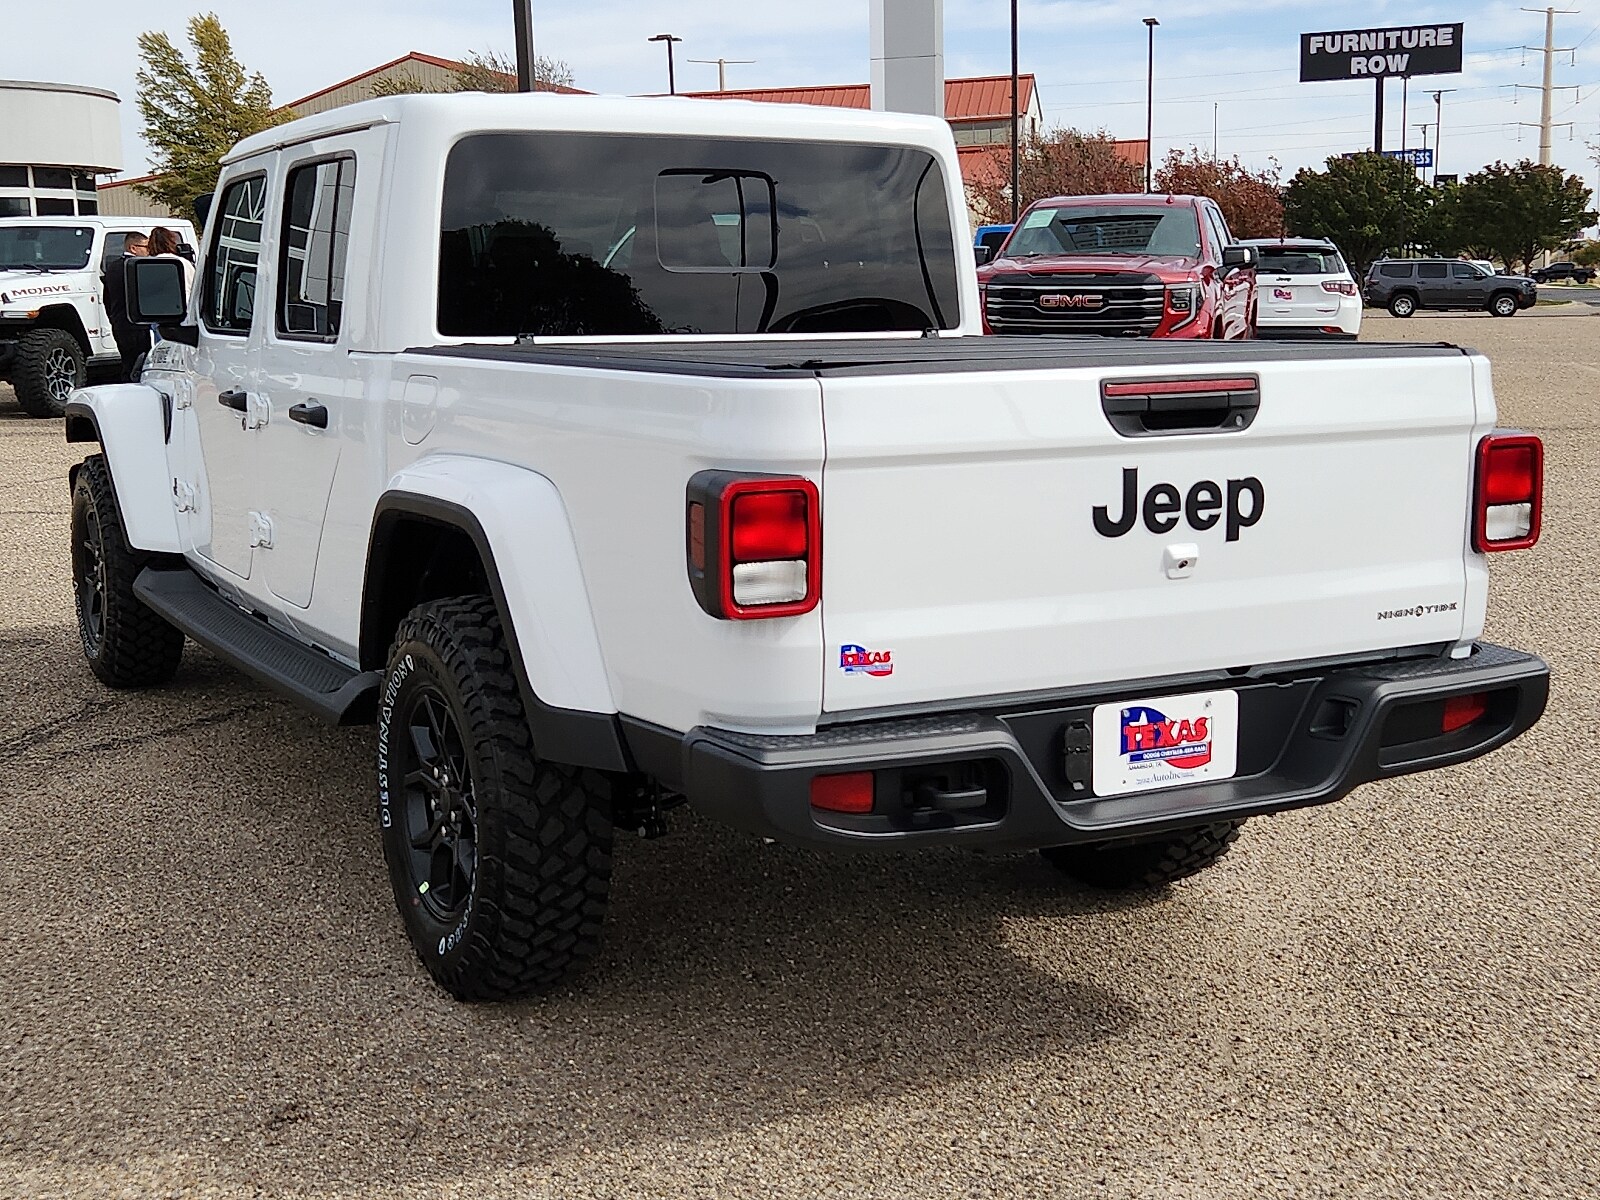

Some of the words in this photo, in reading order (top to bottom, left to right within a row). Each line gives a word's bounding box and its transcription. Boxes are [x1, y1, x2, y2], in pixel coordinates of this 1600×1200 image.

[1309, 26, 1453, 55] FURNITURE
[1350, 53, 1410, 75] ROW
[1389, 151, 1431, 165] ATTRESS
[11, 284, 72, 297] MOJAVE
[1039, 294, 1103, 308] GMC
[1092, 466, 1265, 543] Jeep
[378, 661, 408, 828] DESTINATION
[1124, 717, 1208, 751] TEXAS
